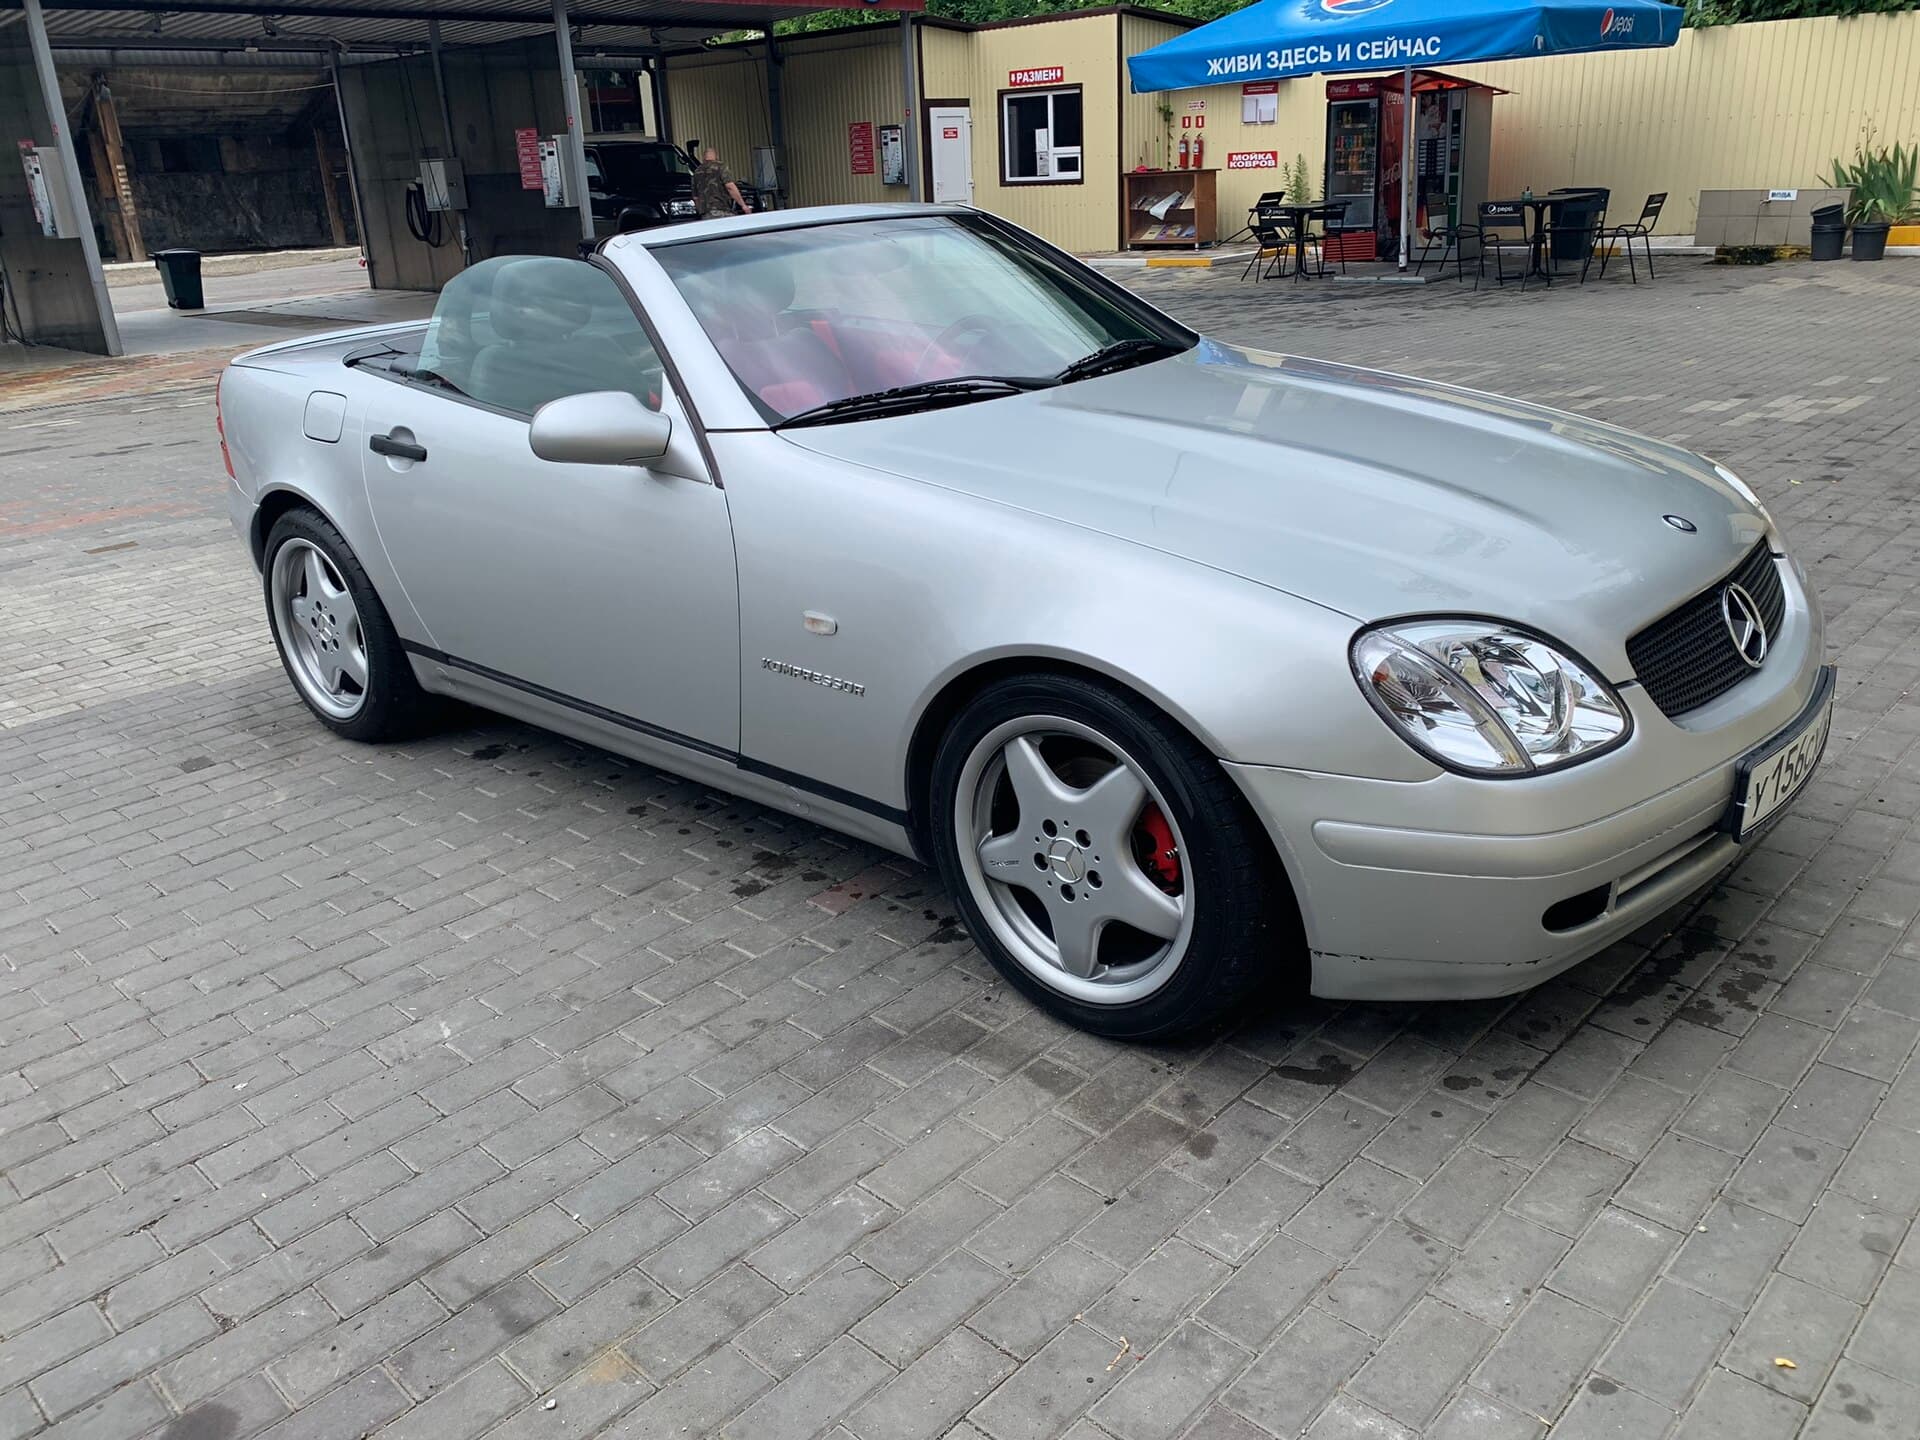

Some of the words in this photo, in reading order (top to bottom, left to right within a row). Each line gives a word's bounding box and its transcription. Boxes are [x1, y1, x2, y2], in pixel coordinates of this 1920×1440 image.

[1609, 13, 1635, 36] pepsi
[1207, 53, 1262, 76] ЖИВИ
[1266, 45, 1332, 70] ЗДЕСЬ
[1337, 43, 1351, 62] И
[1356, 36, 1441, 61] СЕЙЧАС
[1016, 69, 1056, 83] РАЗМЕН
[1230, 159, 1276, 168] КОВРОВ
[1232, 152, 1273, 161] МОЙКА
[761, 657, 866, 698] KOMPRESSOR
